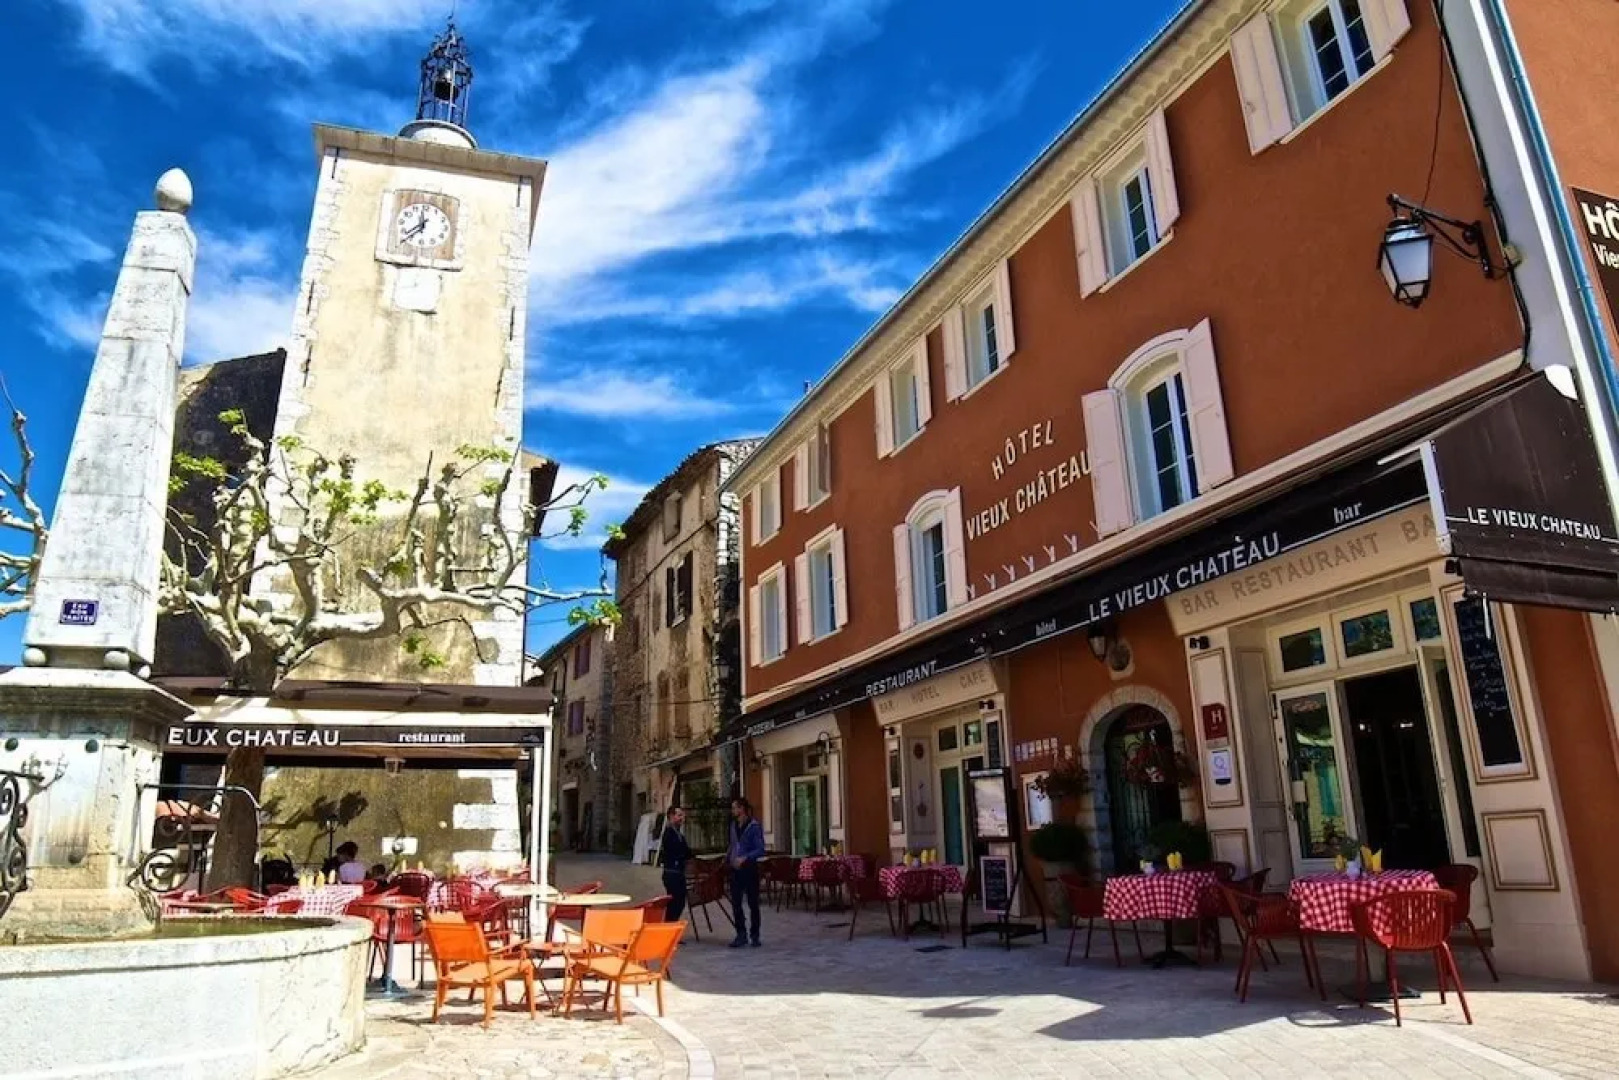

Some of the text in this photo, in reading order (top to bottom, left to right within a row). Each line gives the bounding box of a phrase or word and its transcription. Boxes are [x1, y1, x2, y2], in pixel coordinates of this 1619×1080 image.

[991, 420, 1054, 480] HÔTEL
[966, 450, 1091, 541] VIEUX CHÂTEAU
[1333, 500, 1363, 524] bar
[1467, 506, 1601, 540] LE VIEUX CHATEAU
[1180, 589, 1219, 616] BAR
[1232, 532, 1380, 600] RESTAURANT
[1089, 598, 1110, 622] LE
[1116, 574, 1171, 611] VIEUX
[866, 660, 937, 697] RESTAURANT
[226, 728, 341, 747] CHATEAU
[399, 732, 466, 744] restaurant
